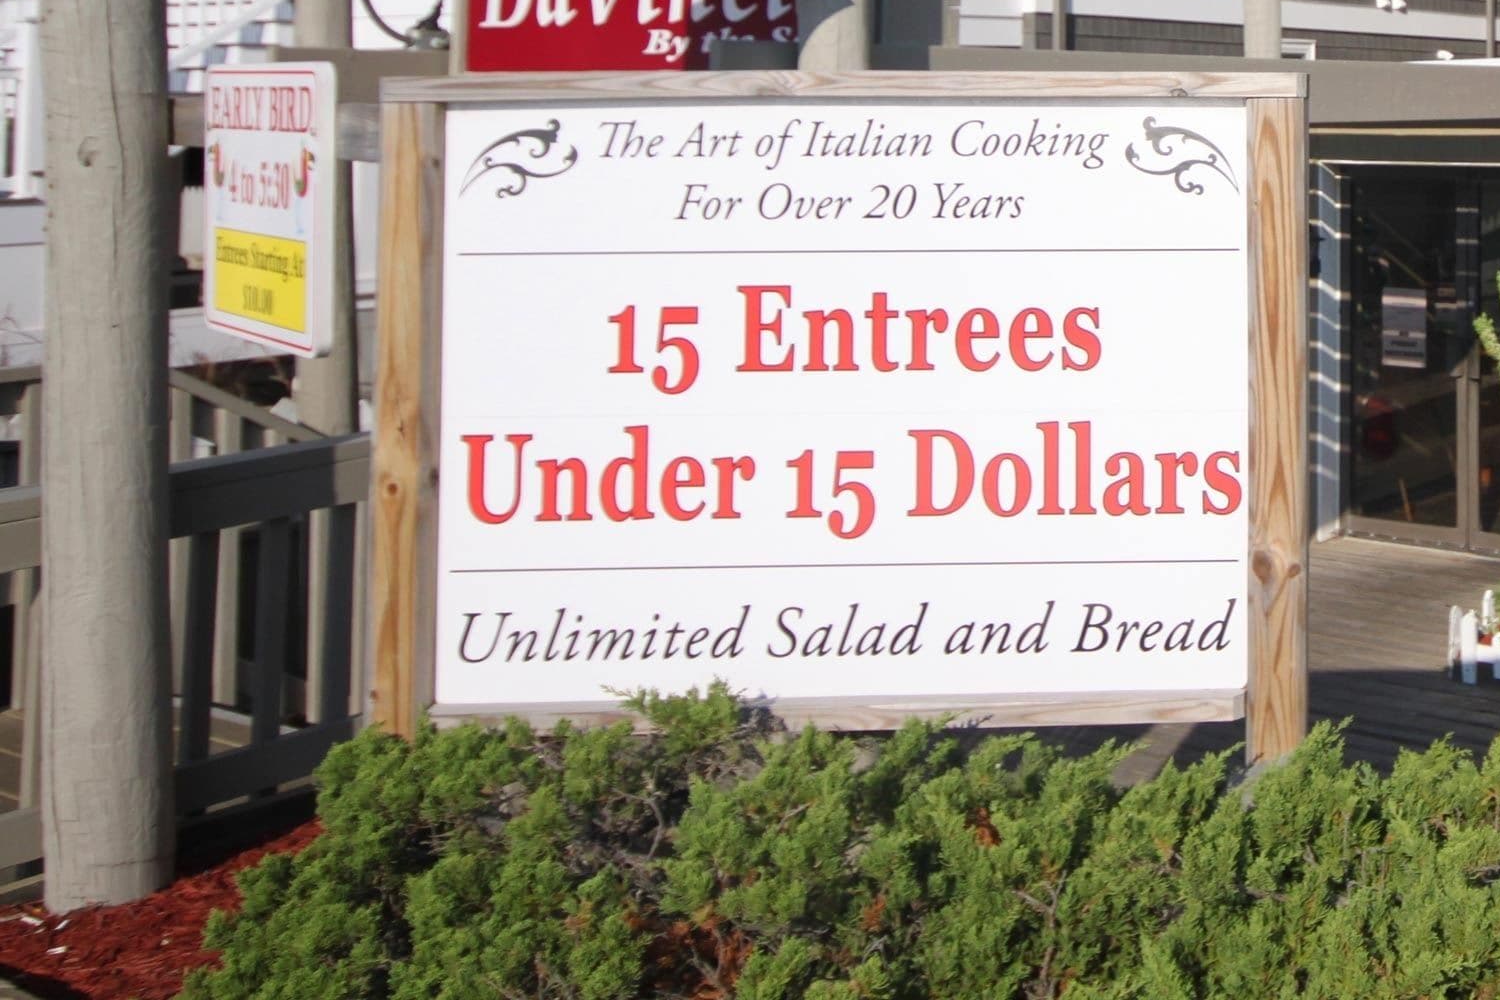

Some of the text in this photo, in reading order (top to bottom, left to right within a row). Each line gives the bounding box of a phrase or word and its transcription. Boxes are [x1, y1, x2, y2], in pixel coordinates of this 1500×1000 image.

[642, 28, 691, 63] By
[210, 87, 311, 133] EARLY BIRD
[600, 118, 1109, 170] The Art of Italian Cooking
[229, 160, 238, 203] 4
[241, 166, 254, 204] to
[674, 183, 1025, 220] For Over 20 Years
[607, 284, 1103, 396] 15 Entrees
[460, 420, 1243, 540] Under 15 Dollars
[458, 598, 1238, 664] Unlimited Salad and Bread
